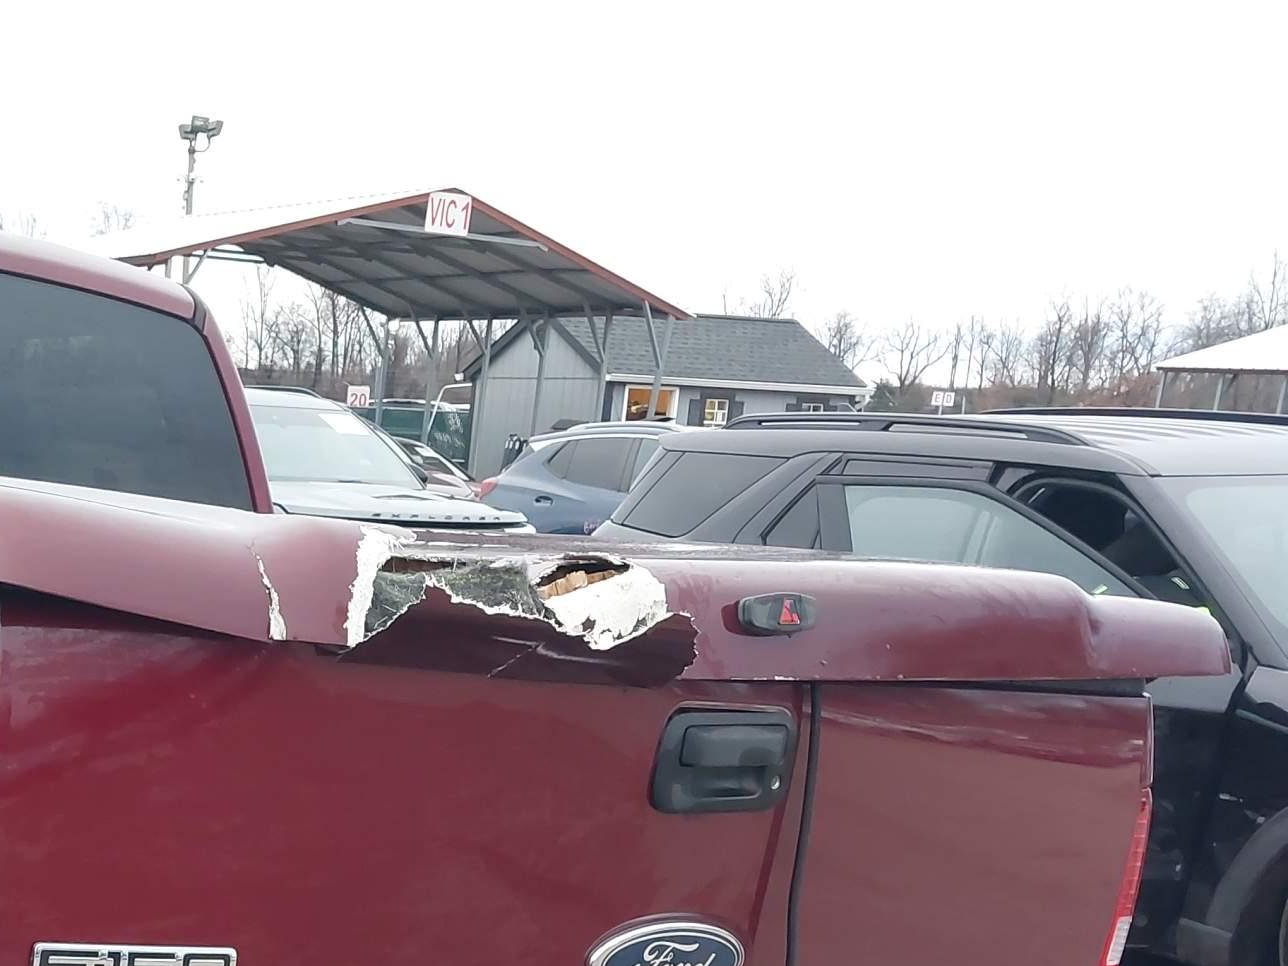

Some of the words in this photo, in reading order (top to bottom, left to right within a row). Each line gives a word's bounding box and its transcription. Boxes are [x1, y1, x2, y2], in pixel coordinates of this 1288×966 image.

[430, 197, 457, 228] VIC
[461, 201, 470, 230] 1
[350, 392, 367, 407] 20
